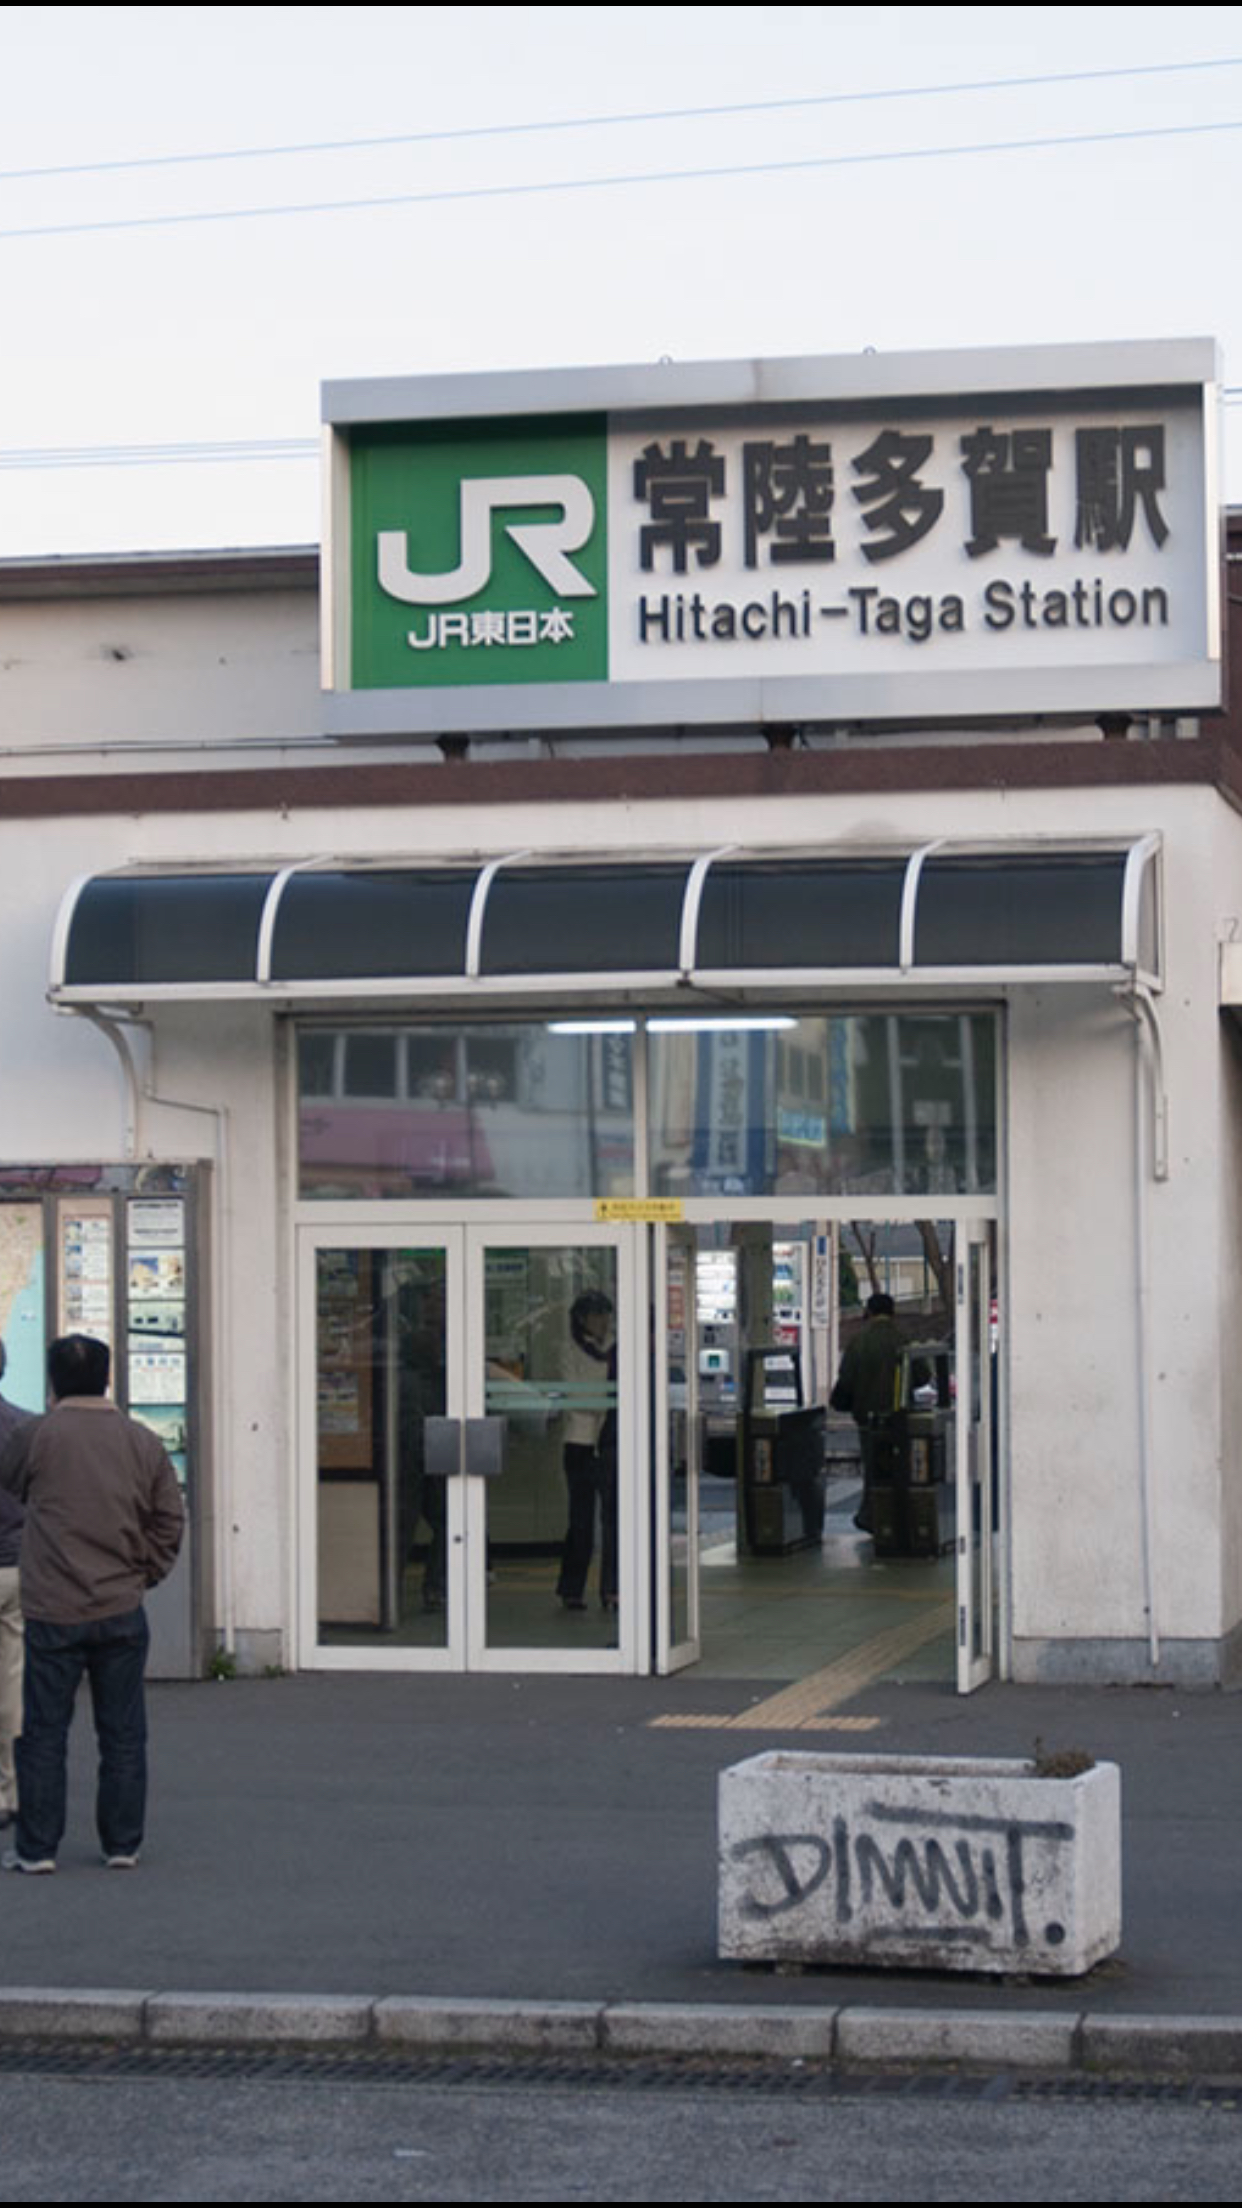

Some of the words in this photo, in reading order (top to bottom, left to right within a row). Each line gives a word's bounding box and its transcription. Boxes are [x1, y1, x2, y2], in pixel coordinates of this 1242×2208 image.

[376, 473, 598, 604] JR
[633, 425, 1170, 575] 常陸多賀駅
[407, 606, 575, 649] JR東日本
[638, 585, 965, 642] Hitachi-Taga
[983, 577, 1169, 631] Station
